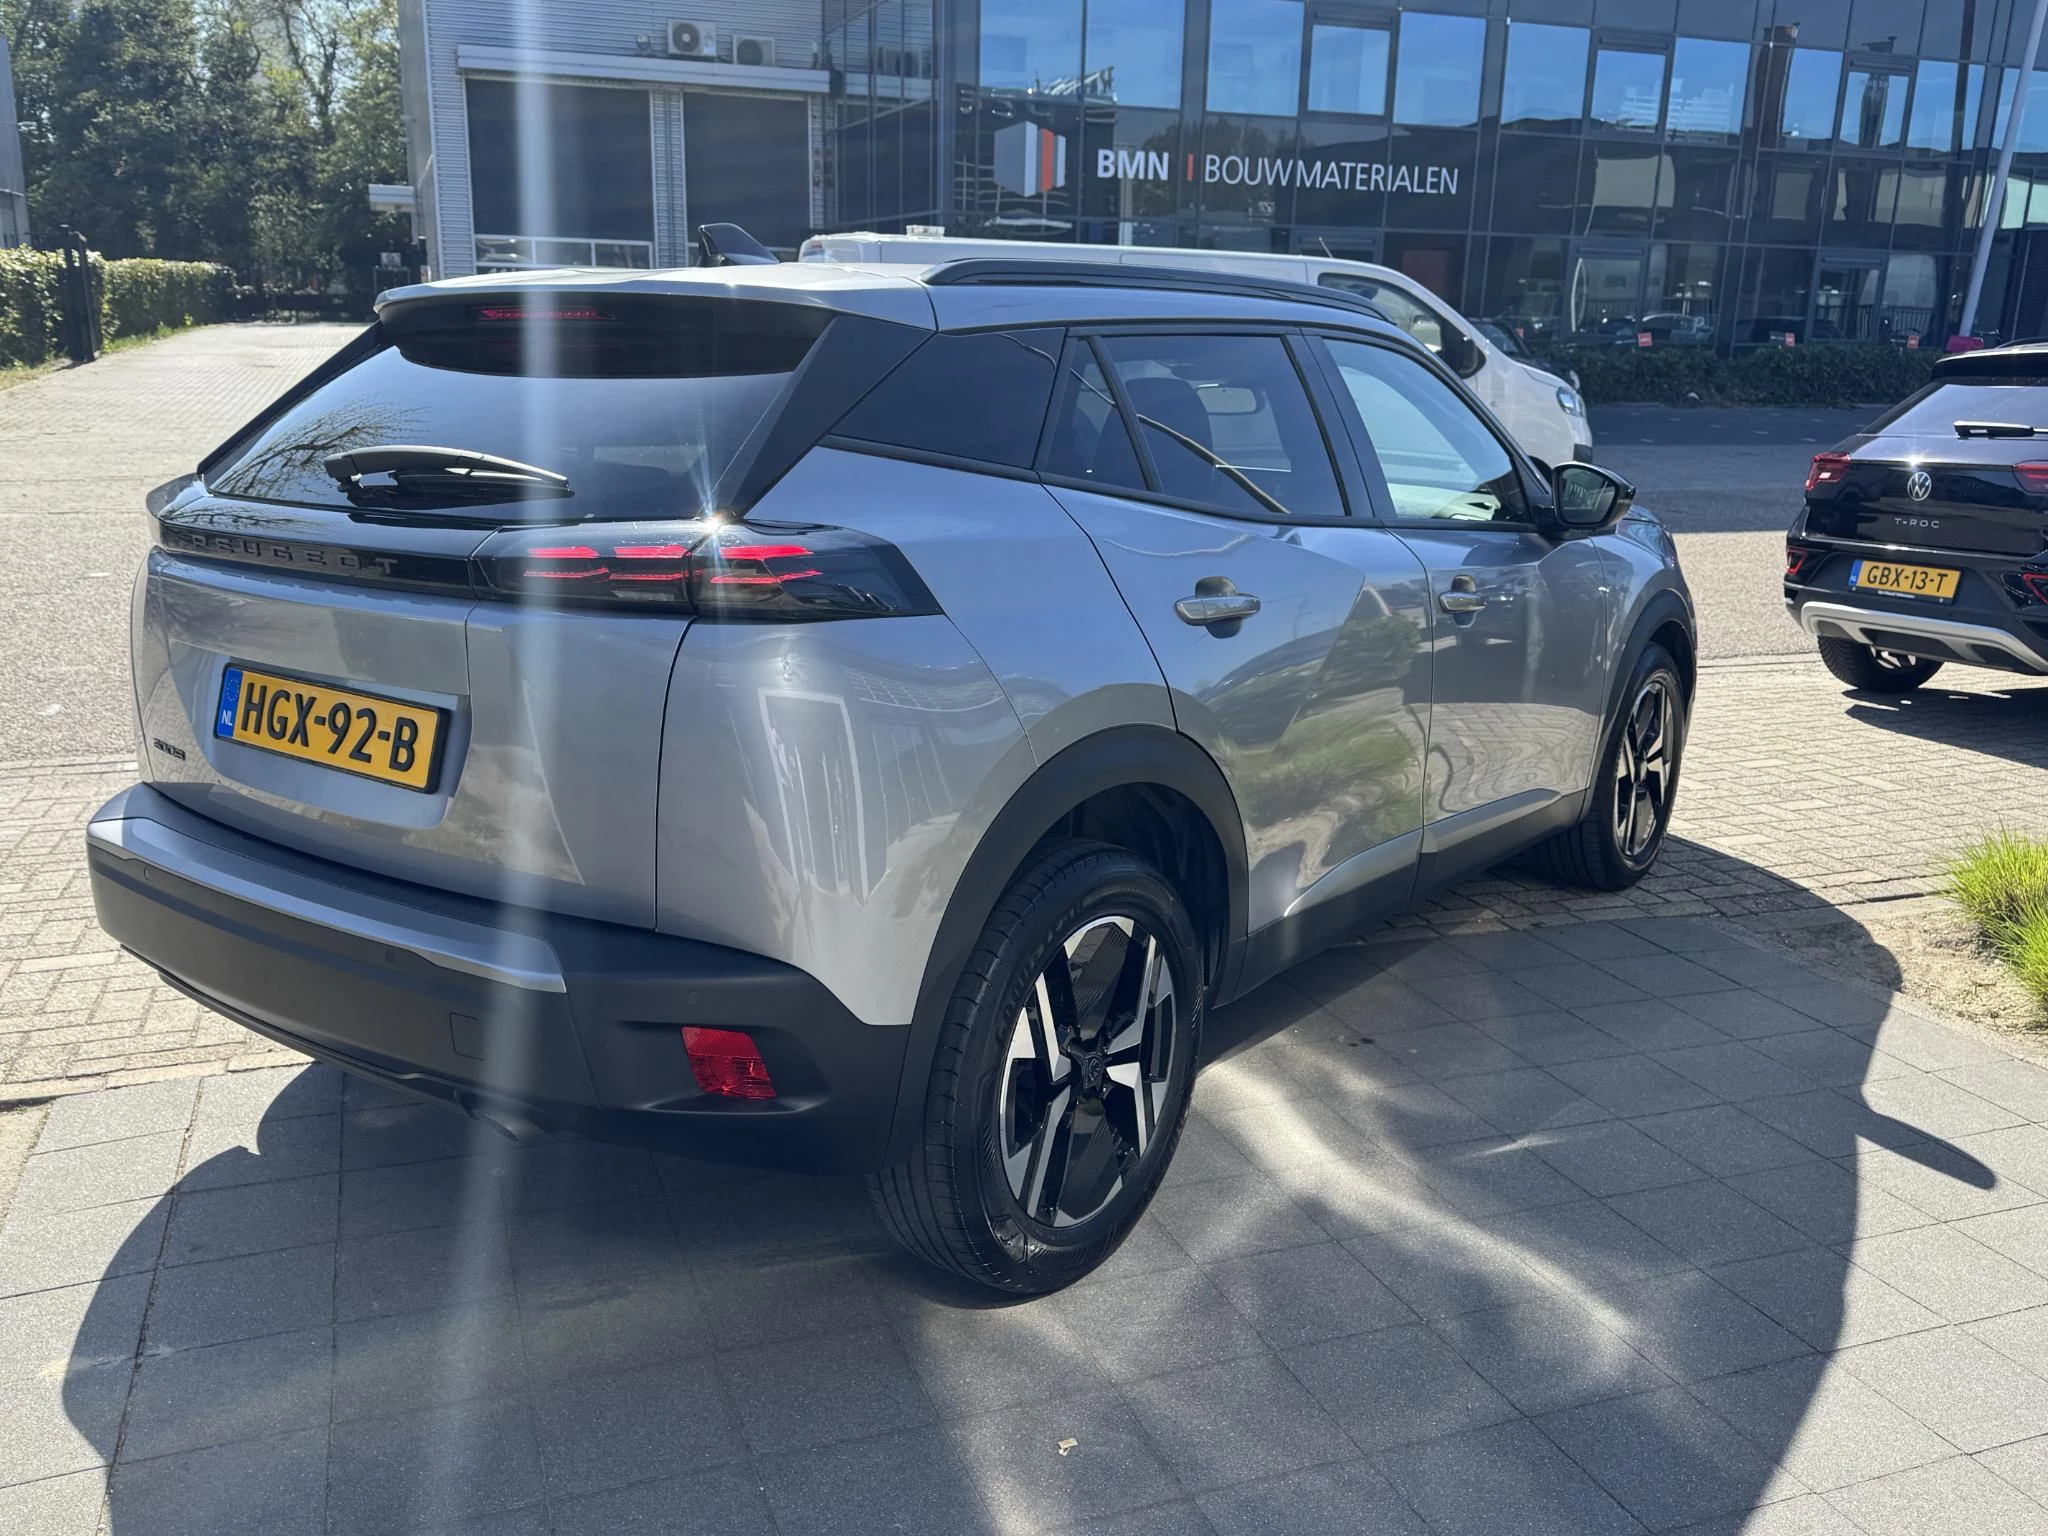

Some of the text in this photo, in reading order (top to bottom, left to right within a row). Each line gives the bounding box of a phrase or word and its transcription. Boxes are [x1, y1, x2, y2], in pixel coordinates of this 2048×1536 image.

[1097, 149, 1459, 195] BMN BOUWMATERIALEN
[1894, 517, 1940, 529] T-ROC
[191, 533, 399, 576] PEUGEOT
[1866, 565, 1949, 593] GBX-13-T
[221, 709, 233, 727] NL
[240, 682, 419, 773] HGX-92-B
